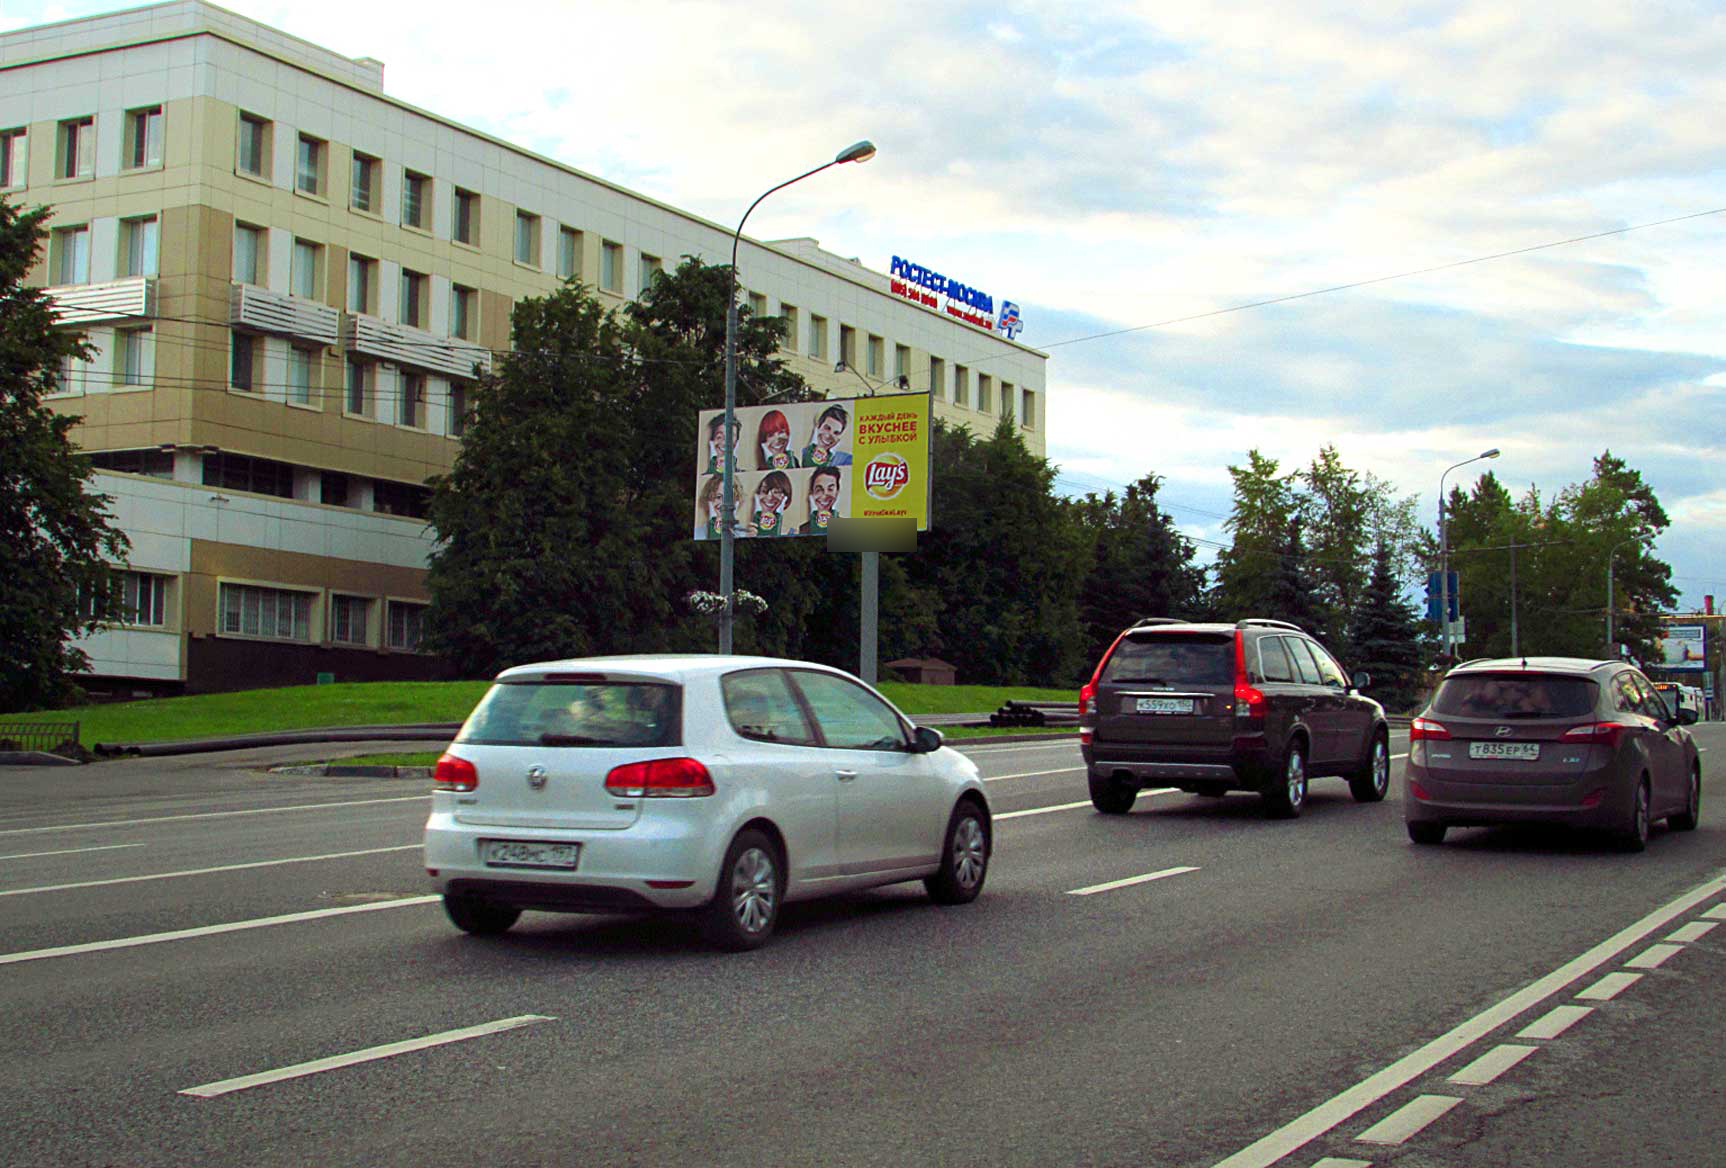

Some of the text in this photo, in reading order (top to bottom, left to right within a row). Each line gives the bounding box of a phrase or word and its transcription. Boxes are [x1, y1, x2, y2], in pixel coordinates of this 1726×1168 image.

[859, 412, 918, 422] КАЖДЫЙ ДЕНЬ
[859, 421, 917, 434] ВКУСНЕЕ
[858, 432, 917, 444] С УЛЫБКОЙ
[868, 463, 906, 491] Lay's
